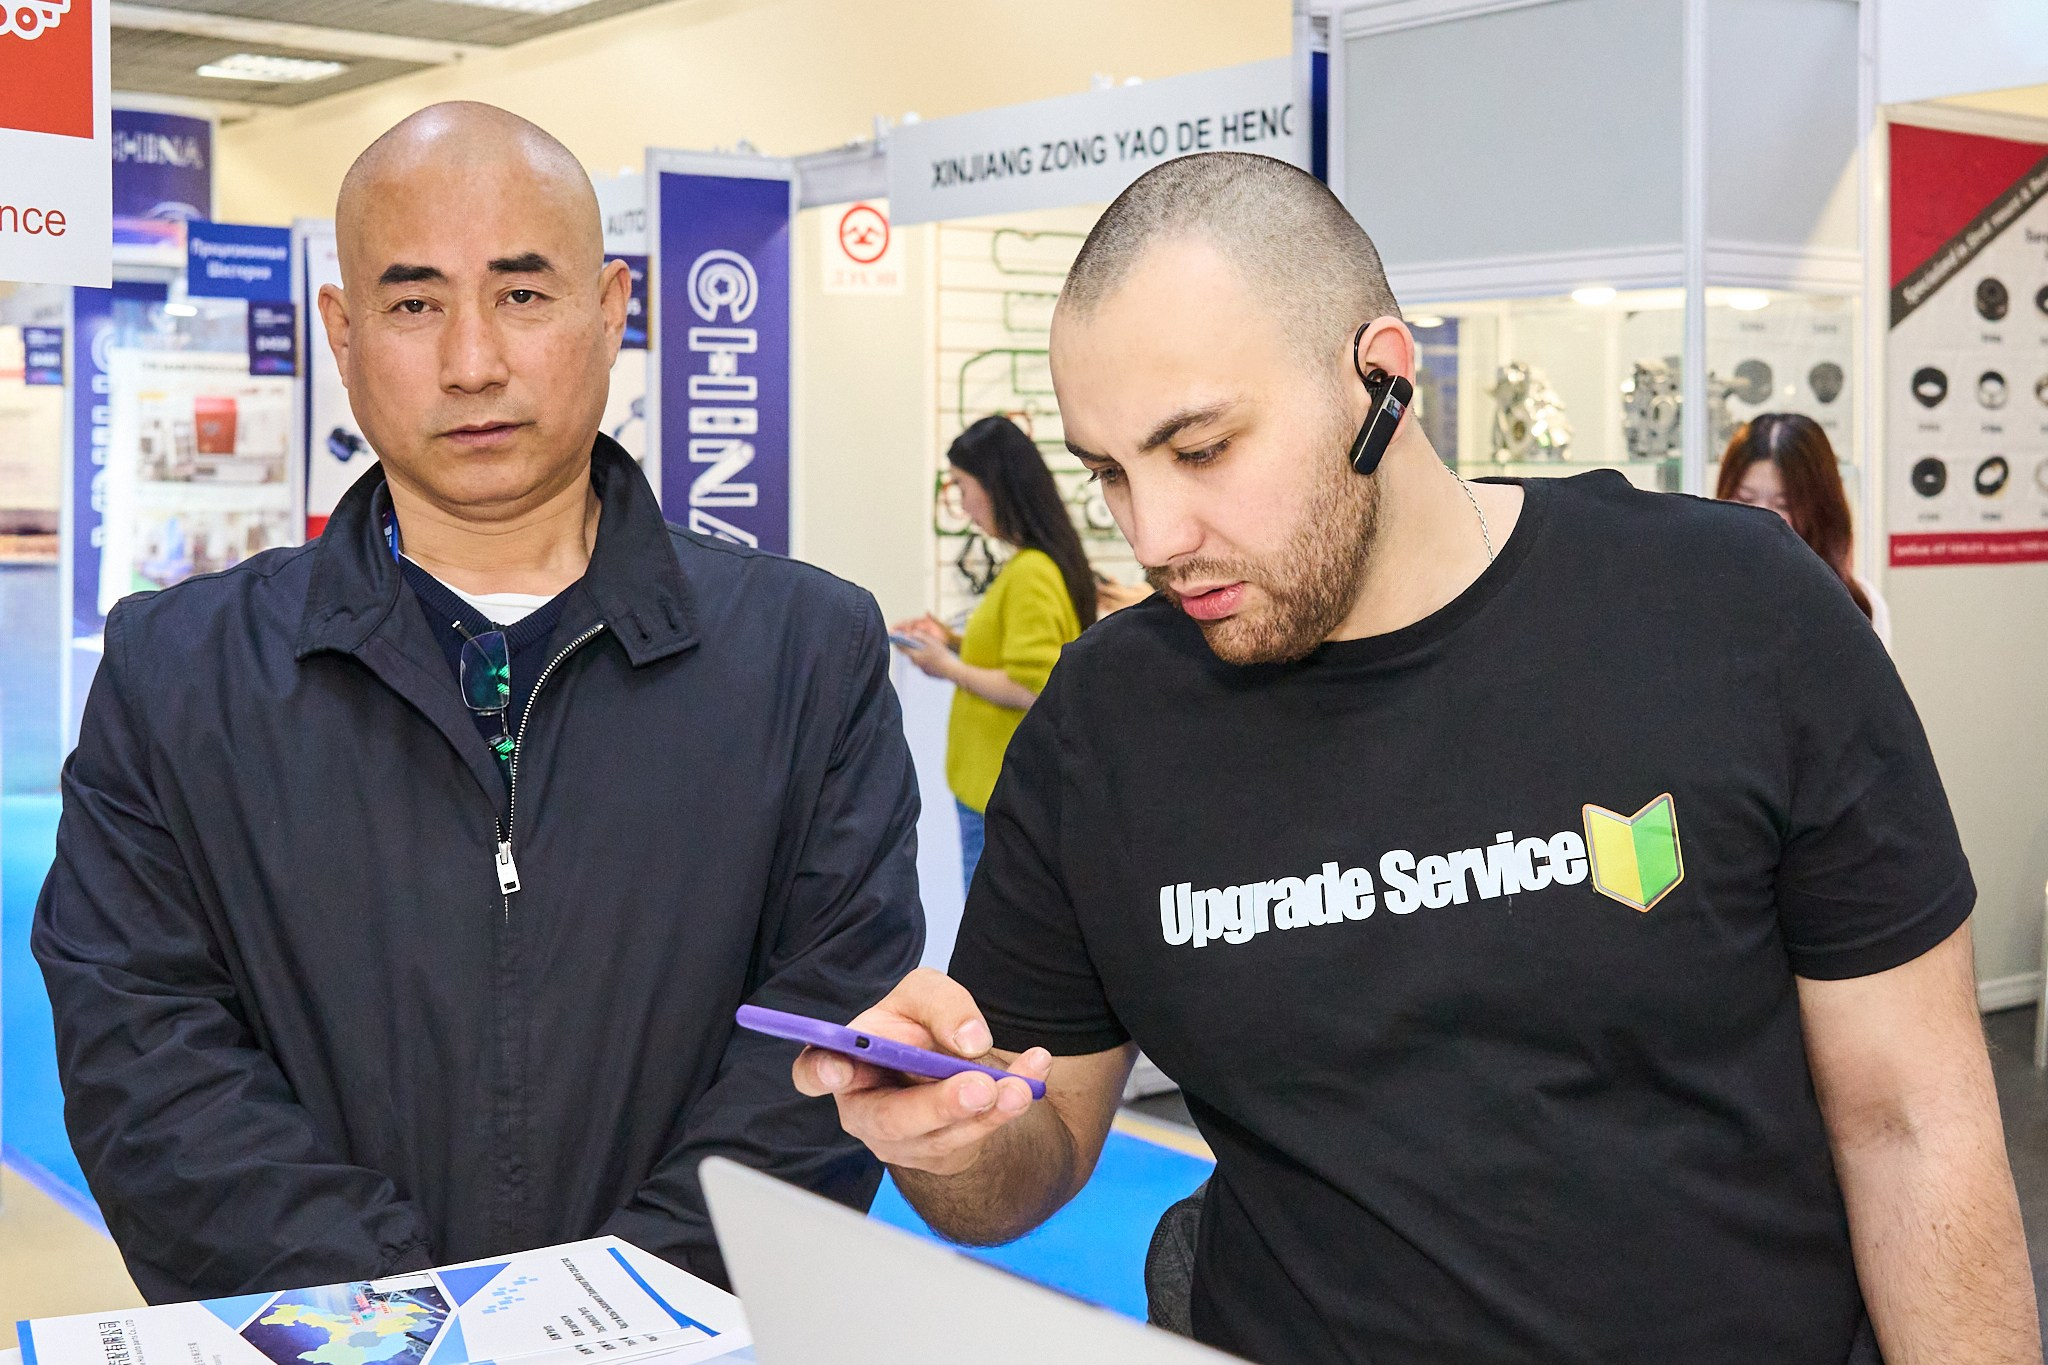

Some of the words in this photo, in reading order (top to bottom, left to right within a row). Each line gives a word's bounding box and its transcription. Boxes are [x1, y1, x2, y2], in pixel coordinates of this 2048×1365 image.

[931, 151, 1032, 189] XINJIANG
[1041, 134, 1107, 173] ZONG
[1114, 125, 1168, 161] YAO
[1177, 118, 1211, 152] DE
[1159, 861, 1376, 949] Upgrade
[1379, 830, 1589, 915] Service
